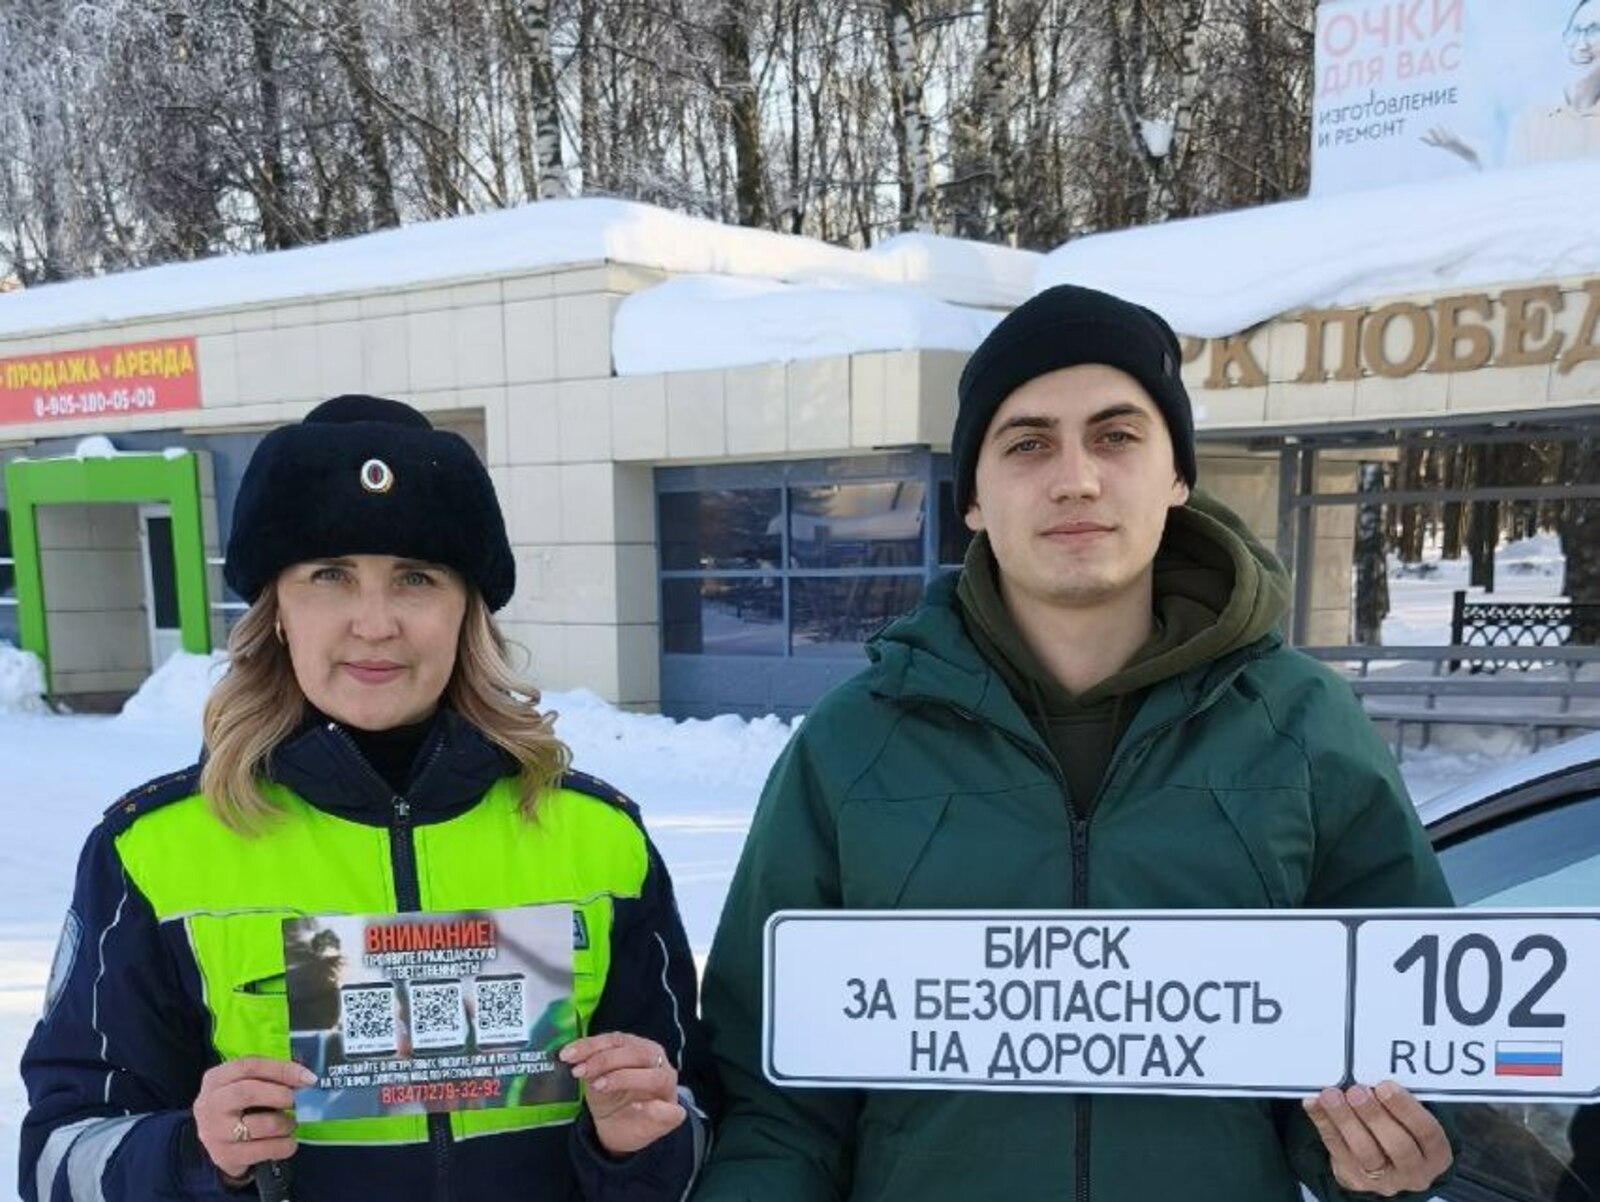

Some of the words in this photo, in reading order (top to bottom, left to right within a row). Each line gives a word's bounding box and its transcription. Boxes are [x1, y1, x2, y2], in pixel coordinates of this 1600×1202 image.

[1322, 0, 1464, 57] ОЧКИ
[1321, 57, 1384, 98] ДЛЯ
[1396, 43, 1464, 80] ВАС
[1319, 87, 1459, 126] ИЗГОТОВЛЕНИЕ
[1317, 132, 1330, 149] И
[1335, 118, 1408, 145] РЕМОНТ
[7, 355, 101, 390] ПРОДАЖА
[113, 344, 194, 379] АРЕНДА
[366, 920, 496, 952] ВНИМАНИЕ!
[984, 925, 1131, 969] БИРСК
[842, 978, 897, 1020] ЗА
[914, 979, 1283, 1025] БЕЗОПАСНОСТЬ
[1393, 933, 1568, 1028] 102
[910, 1030, 969, 1073] НА
[987, 1031, 1207, 1079] ДОРОГАХ
[1390, 1039, 1486, 1076] RUS
